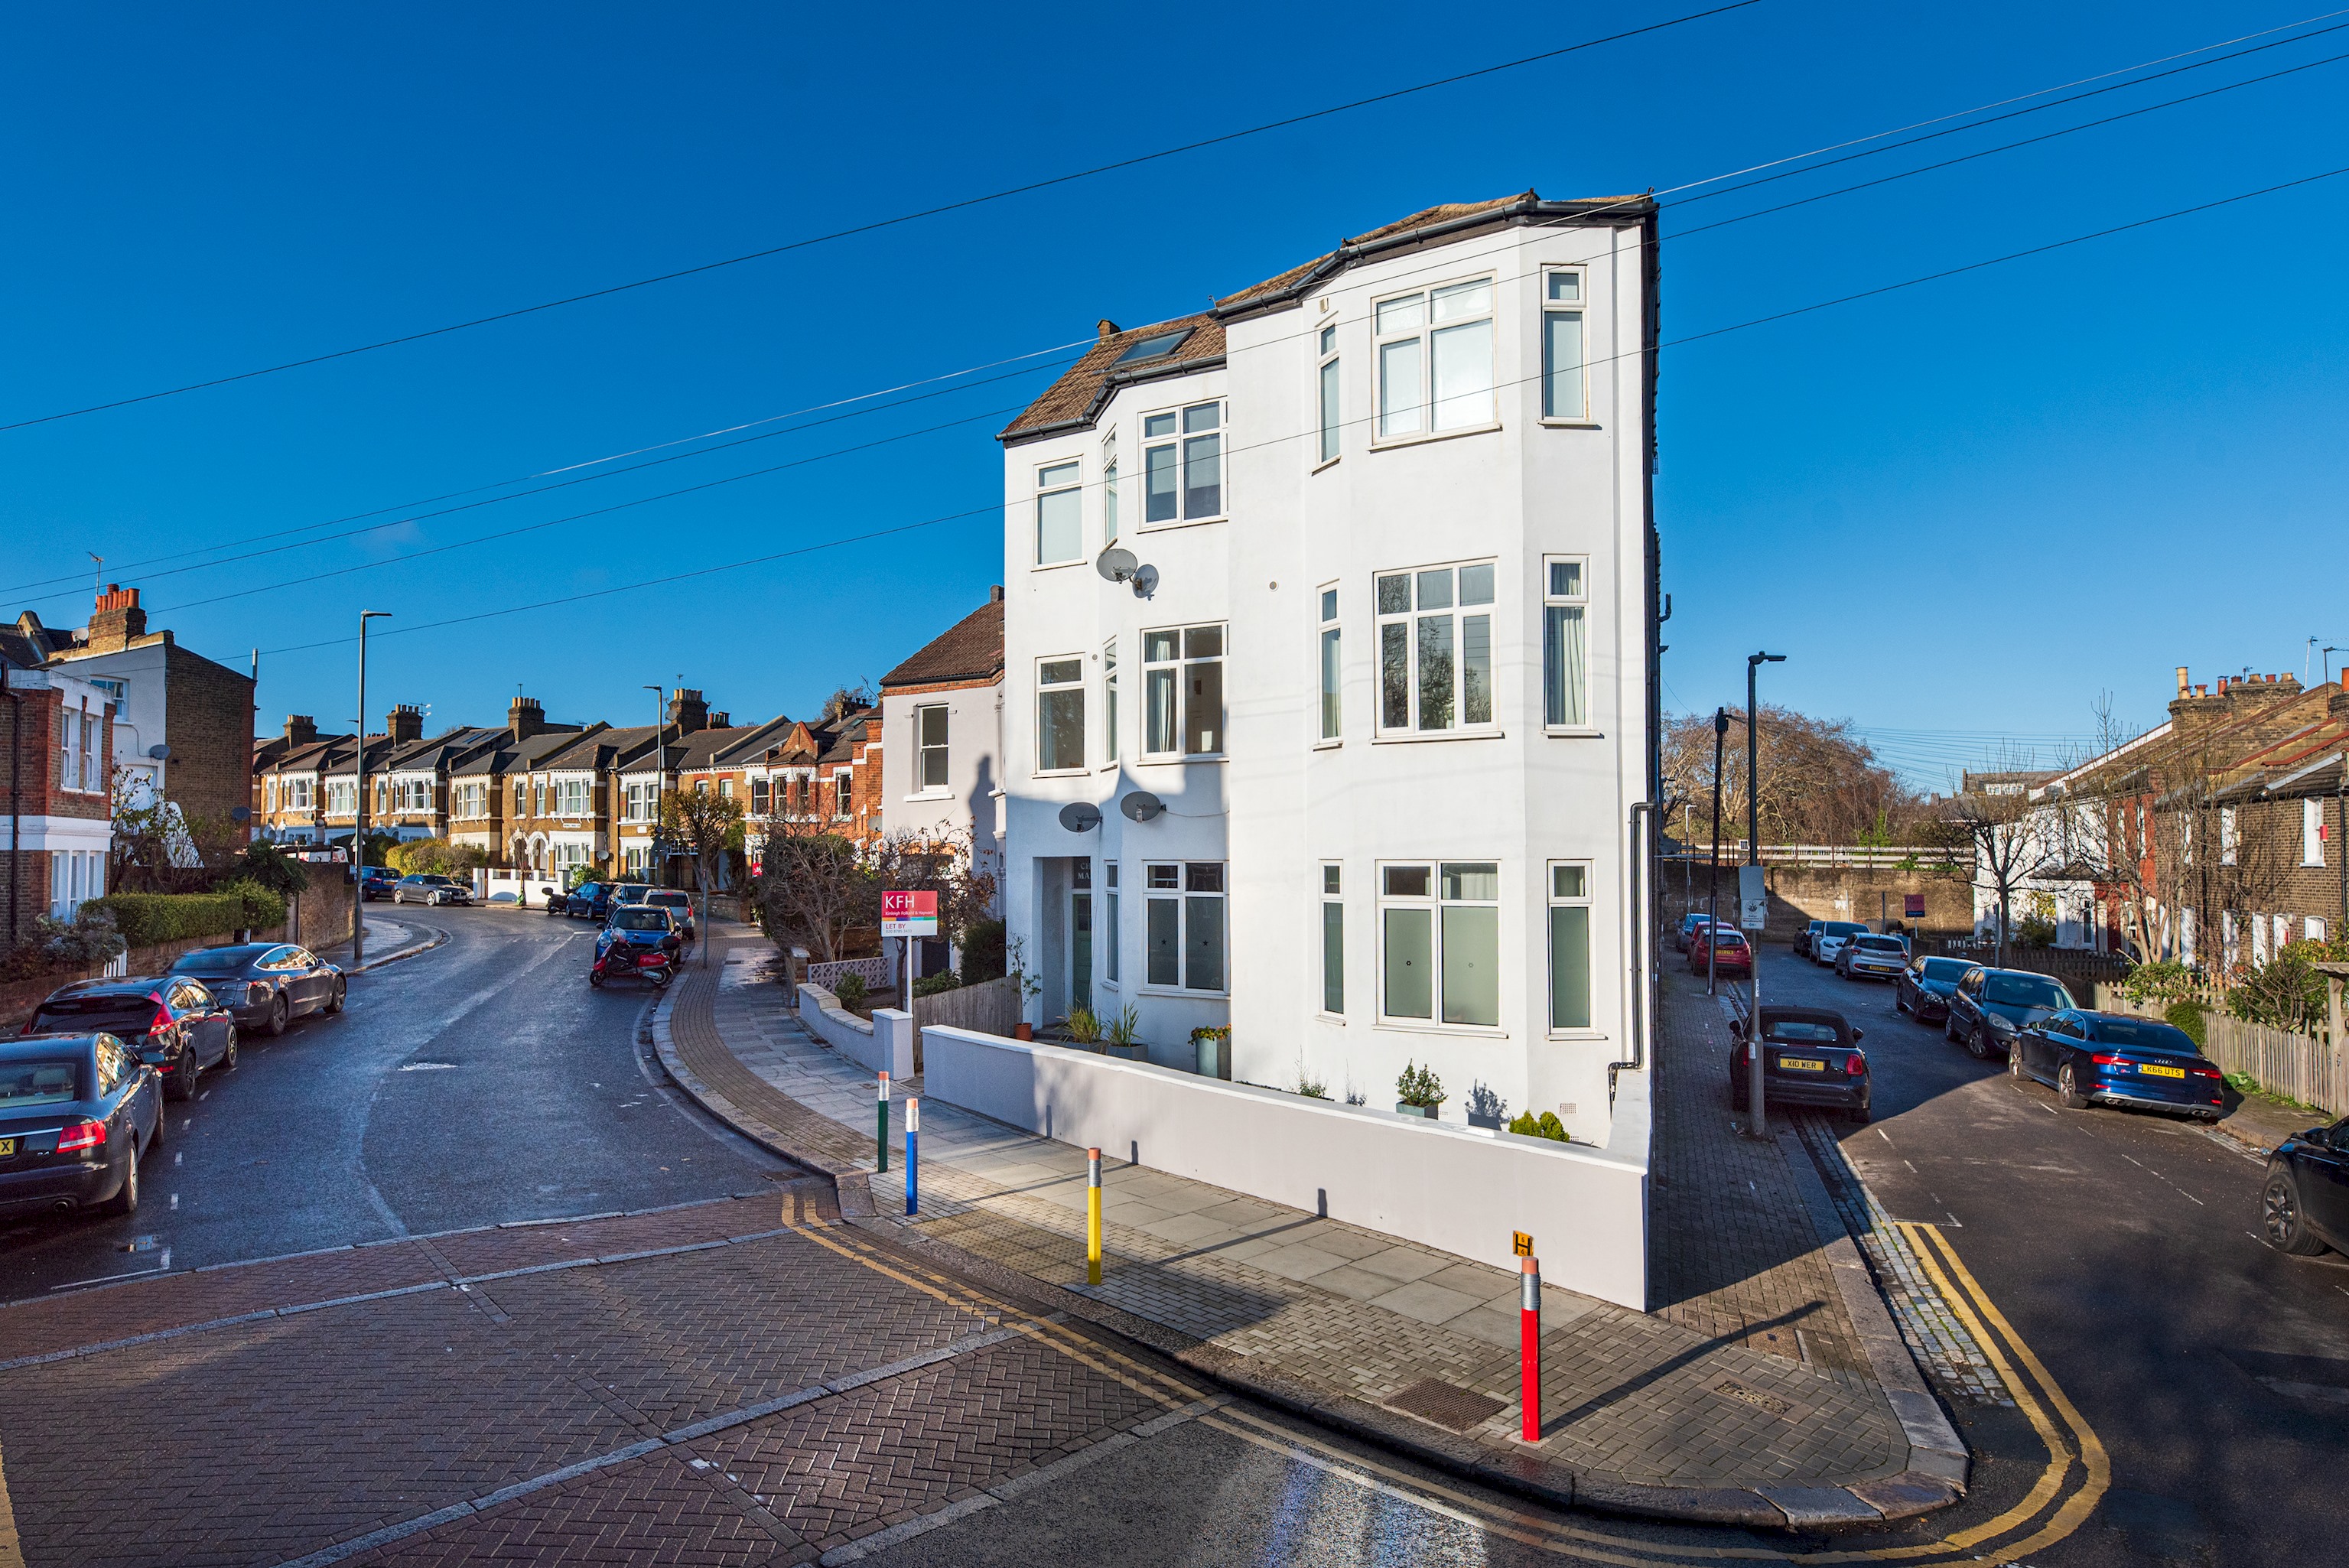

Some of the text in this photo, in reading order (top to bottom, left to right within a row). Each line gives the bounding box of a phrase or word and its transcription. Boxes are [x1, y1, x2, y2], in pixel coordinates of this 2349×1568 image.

[885, 895, 915, 909] KFH
[2142, 1065, 2163, 1074] LK66
[1515, 1234, 1531, 1256] H
